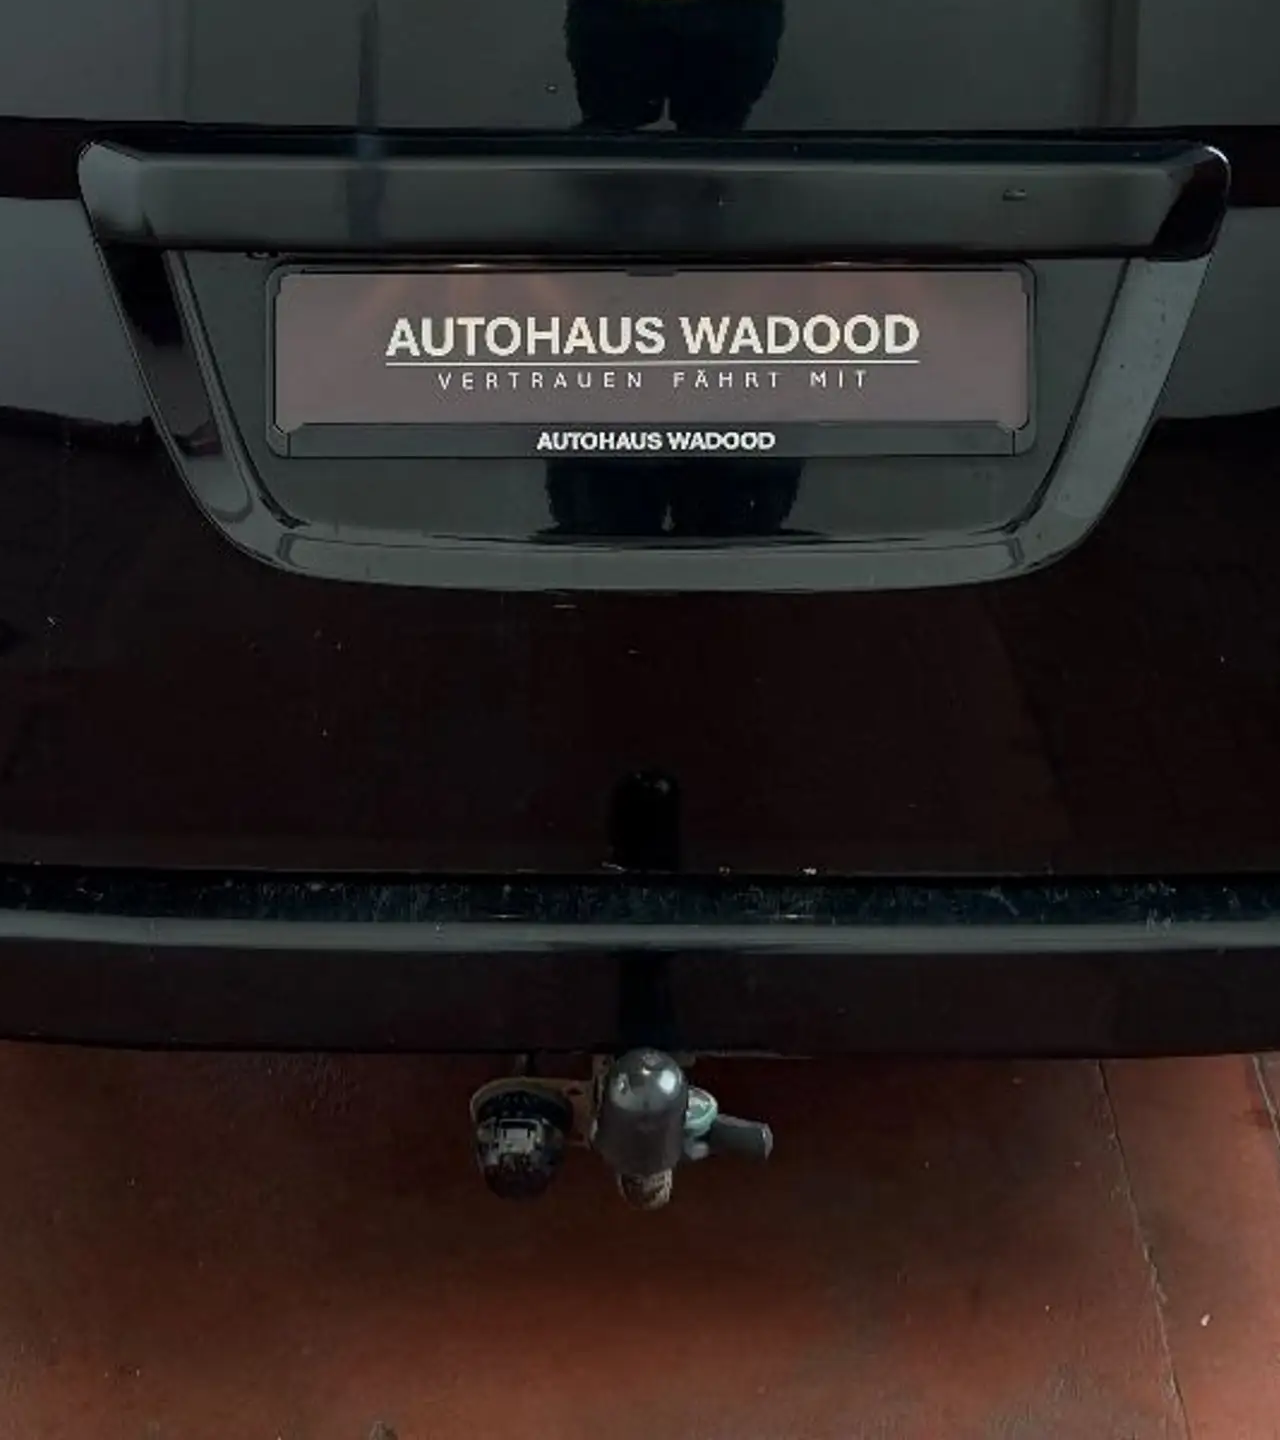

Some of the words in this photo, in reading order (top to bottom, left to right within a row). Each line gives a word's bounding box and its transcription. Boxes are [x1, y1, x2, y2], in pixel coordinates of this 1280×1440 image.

[384, 315, 667, 357] AUTOHAUS
[677, 313, 920, 355] WADOOD
[437, 371, 643, 391] VERTRAUEN
[673, 368, 782, 389] FÄHRT
[810, 370, 868, 388] MIT
[536, 431, 663, 451] AUTOHAUS
[667, 431, 776, 451] WADOOD
